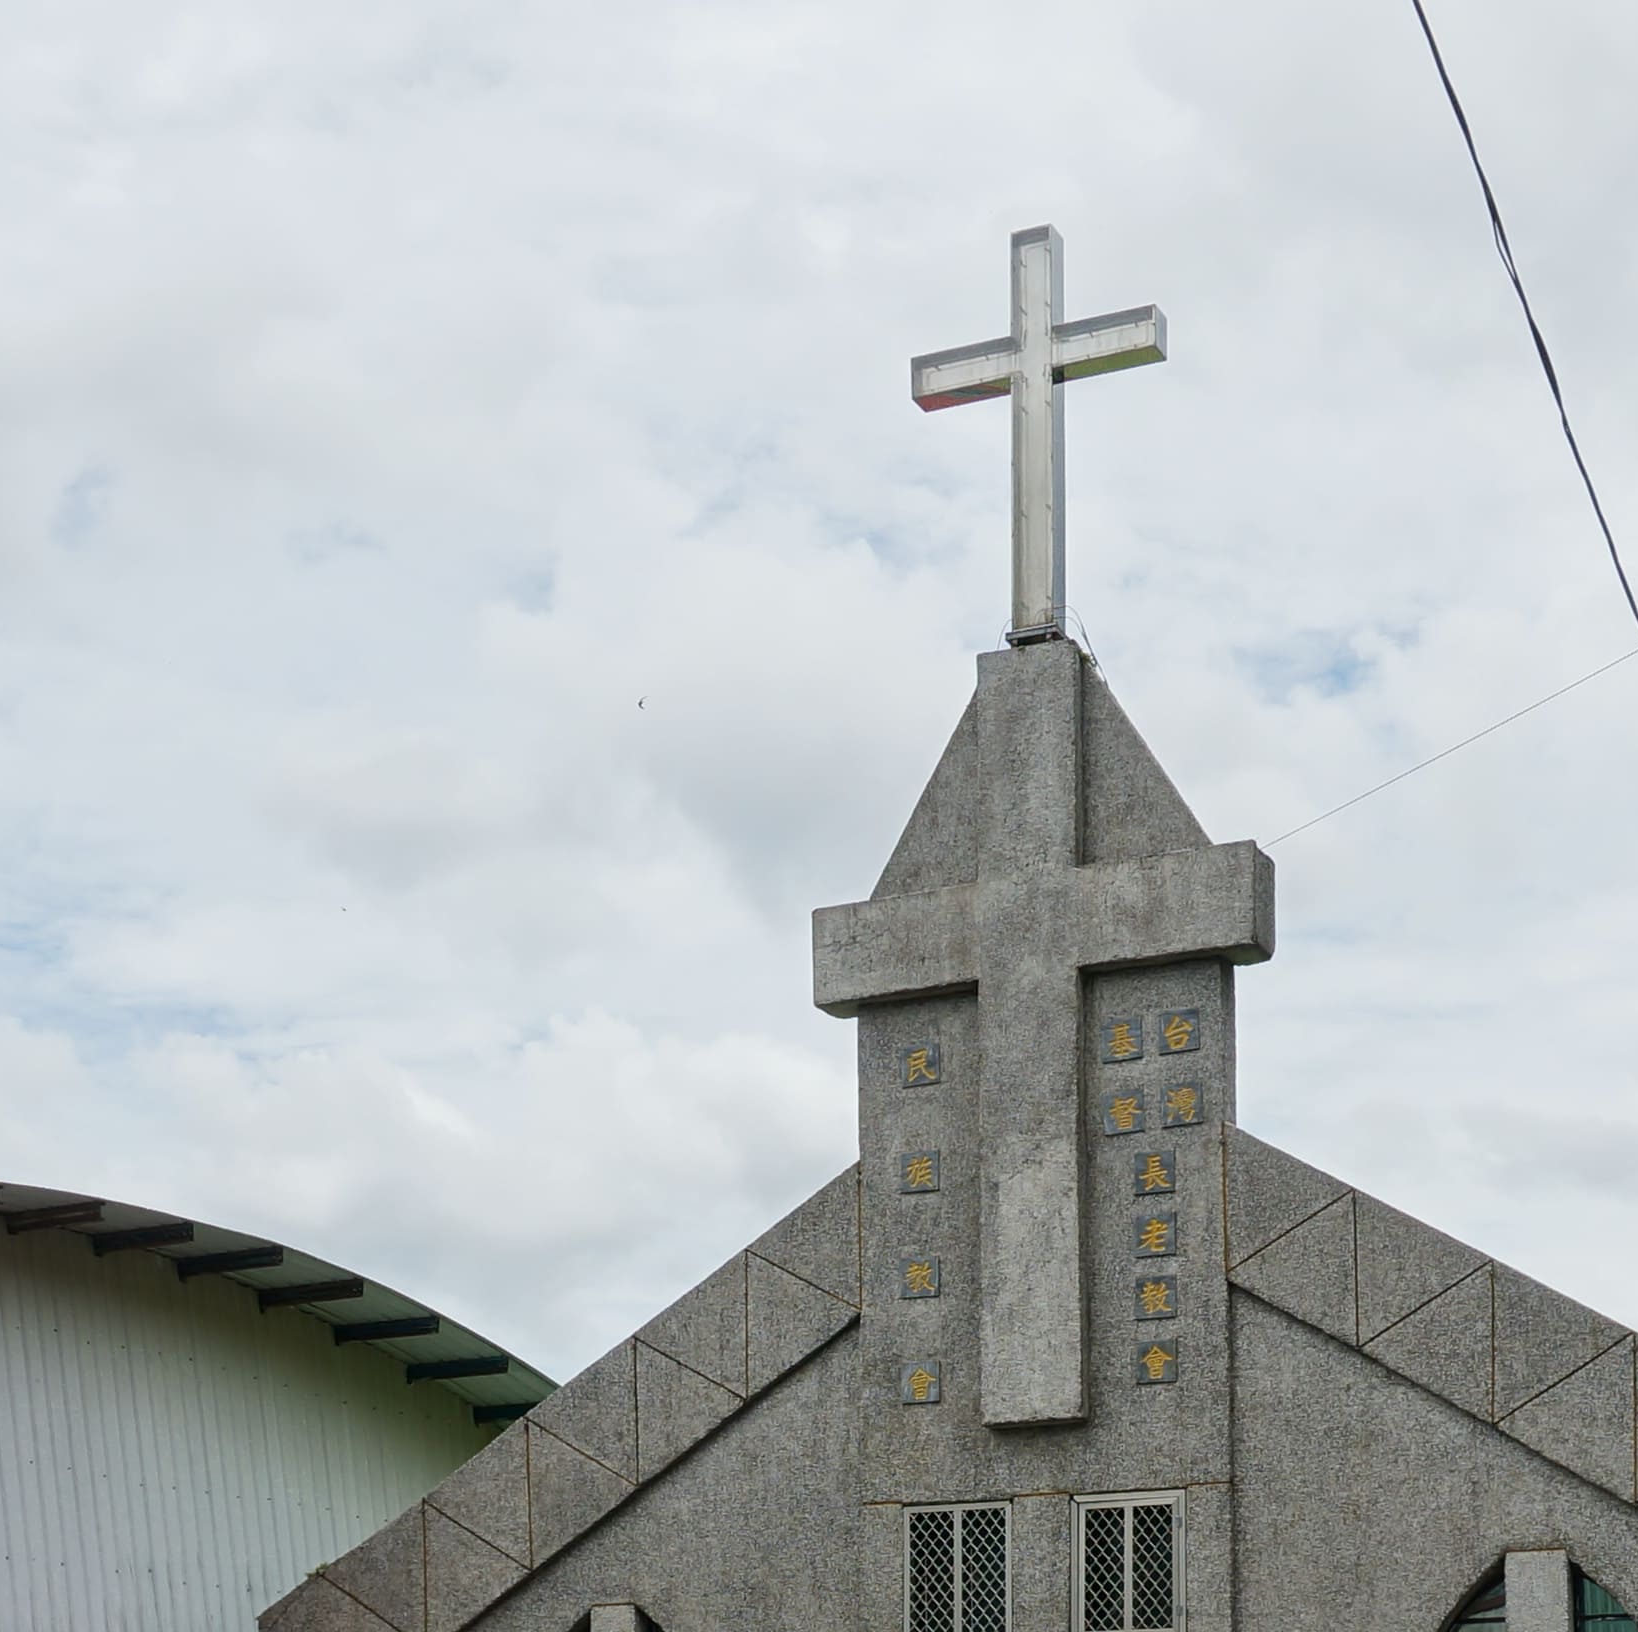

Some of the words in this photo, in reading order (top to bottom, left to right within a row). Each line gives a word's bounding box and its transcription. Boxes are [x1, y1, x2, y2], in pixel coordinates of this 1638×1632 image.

[1107, 1023, 1142, 1129] 基督
[1164, 1014, 1195, 1122] 台灣
[906, 1048, 935, 1399] 民族教會
[1139, 1156, 1173, 1379] 長老教會
